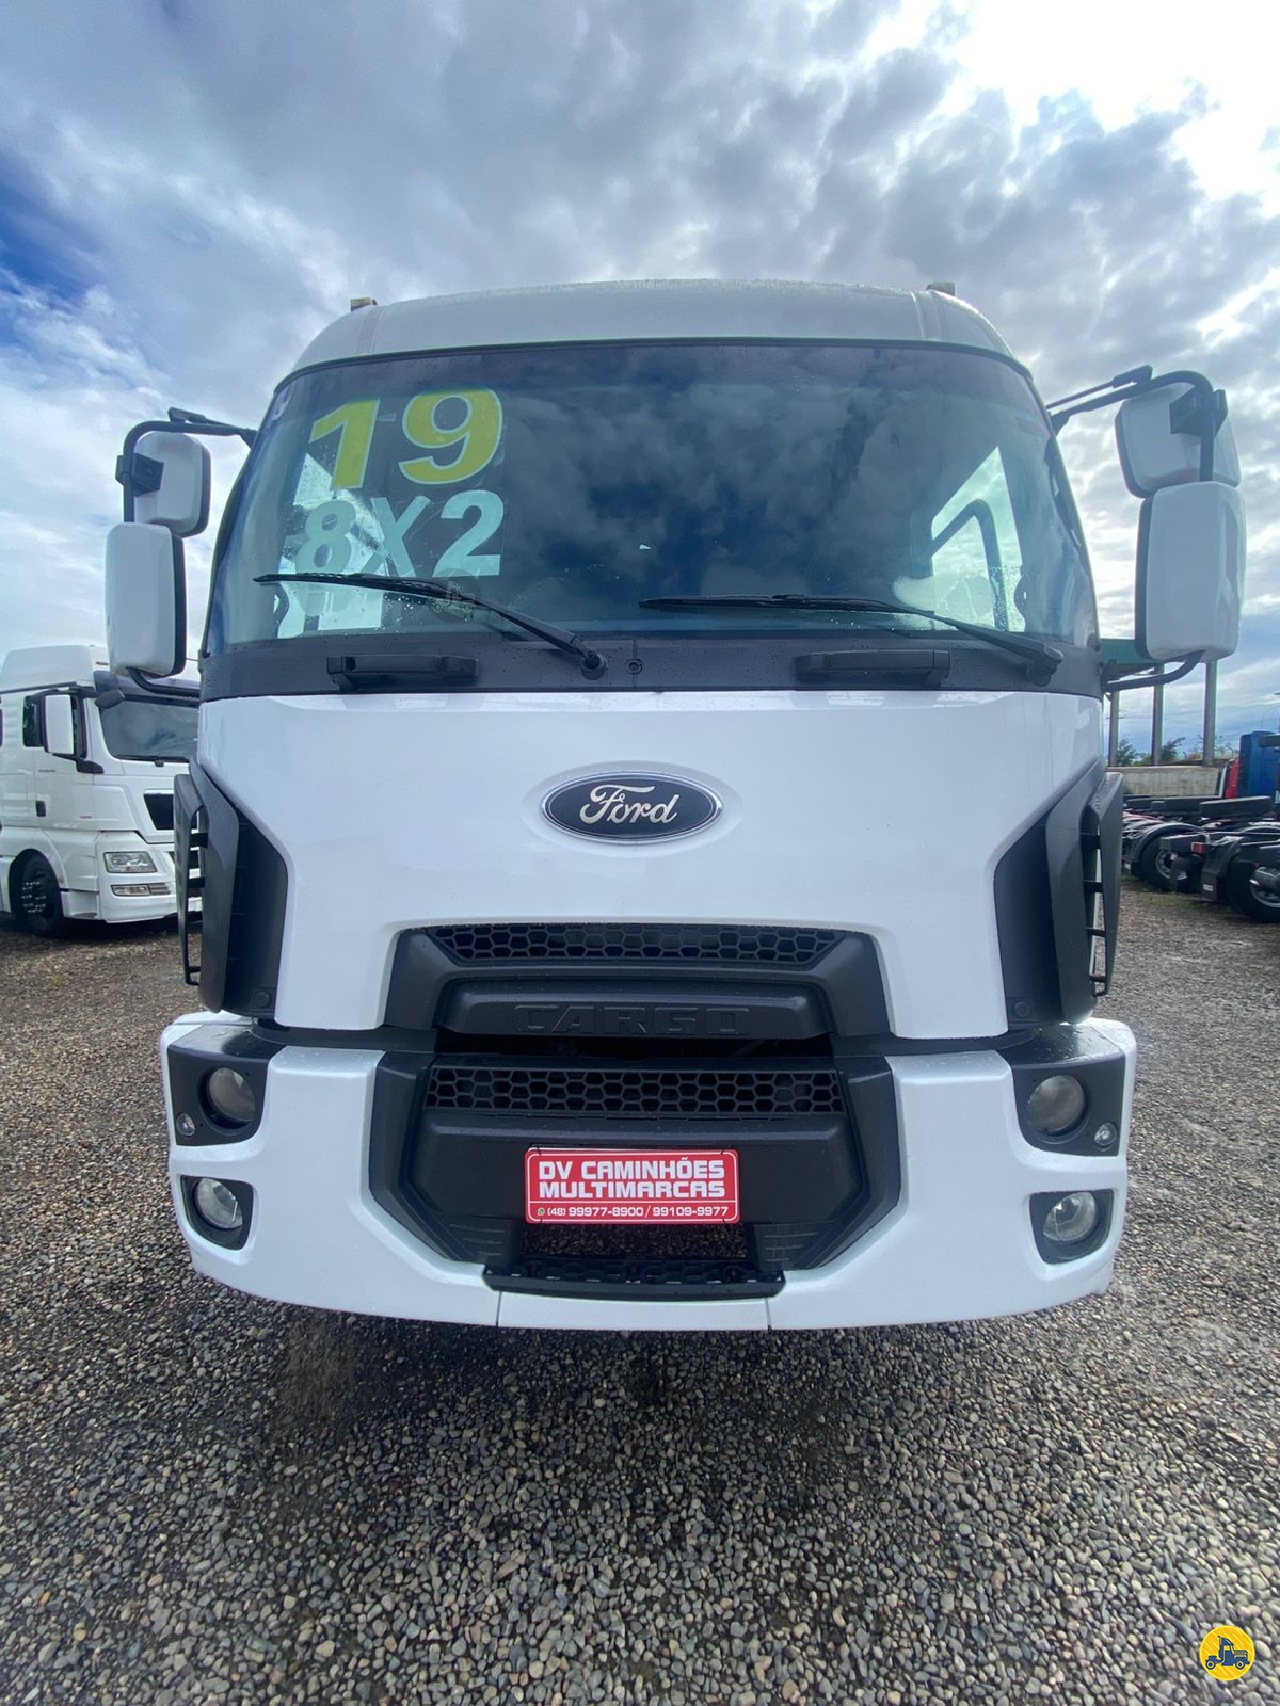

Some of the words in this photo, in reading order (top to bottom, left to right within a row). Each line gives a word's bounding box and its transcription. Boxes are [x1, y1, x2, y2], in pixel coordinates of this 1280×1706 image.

[308, 388, 502, 489] 19
[295, 489, 503, 578] 8X2
[579, 784, 680, 824] Ford
[512, 1004, 751, 1034] CARGO
[538, 1161, 573, 1180] DV
[580, 1157, 725, 1179] CAMINHÕES
[539, 1180, 726, 1198] MULTIMARCAS
[547, 1207, 566, 1217] (48)
[569, 1206, 644, 1217] 99977-8900
[652, 1206, 729, 1217] 99109-9977
